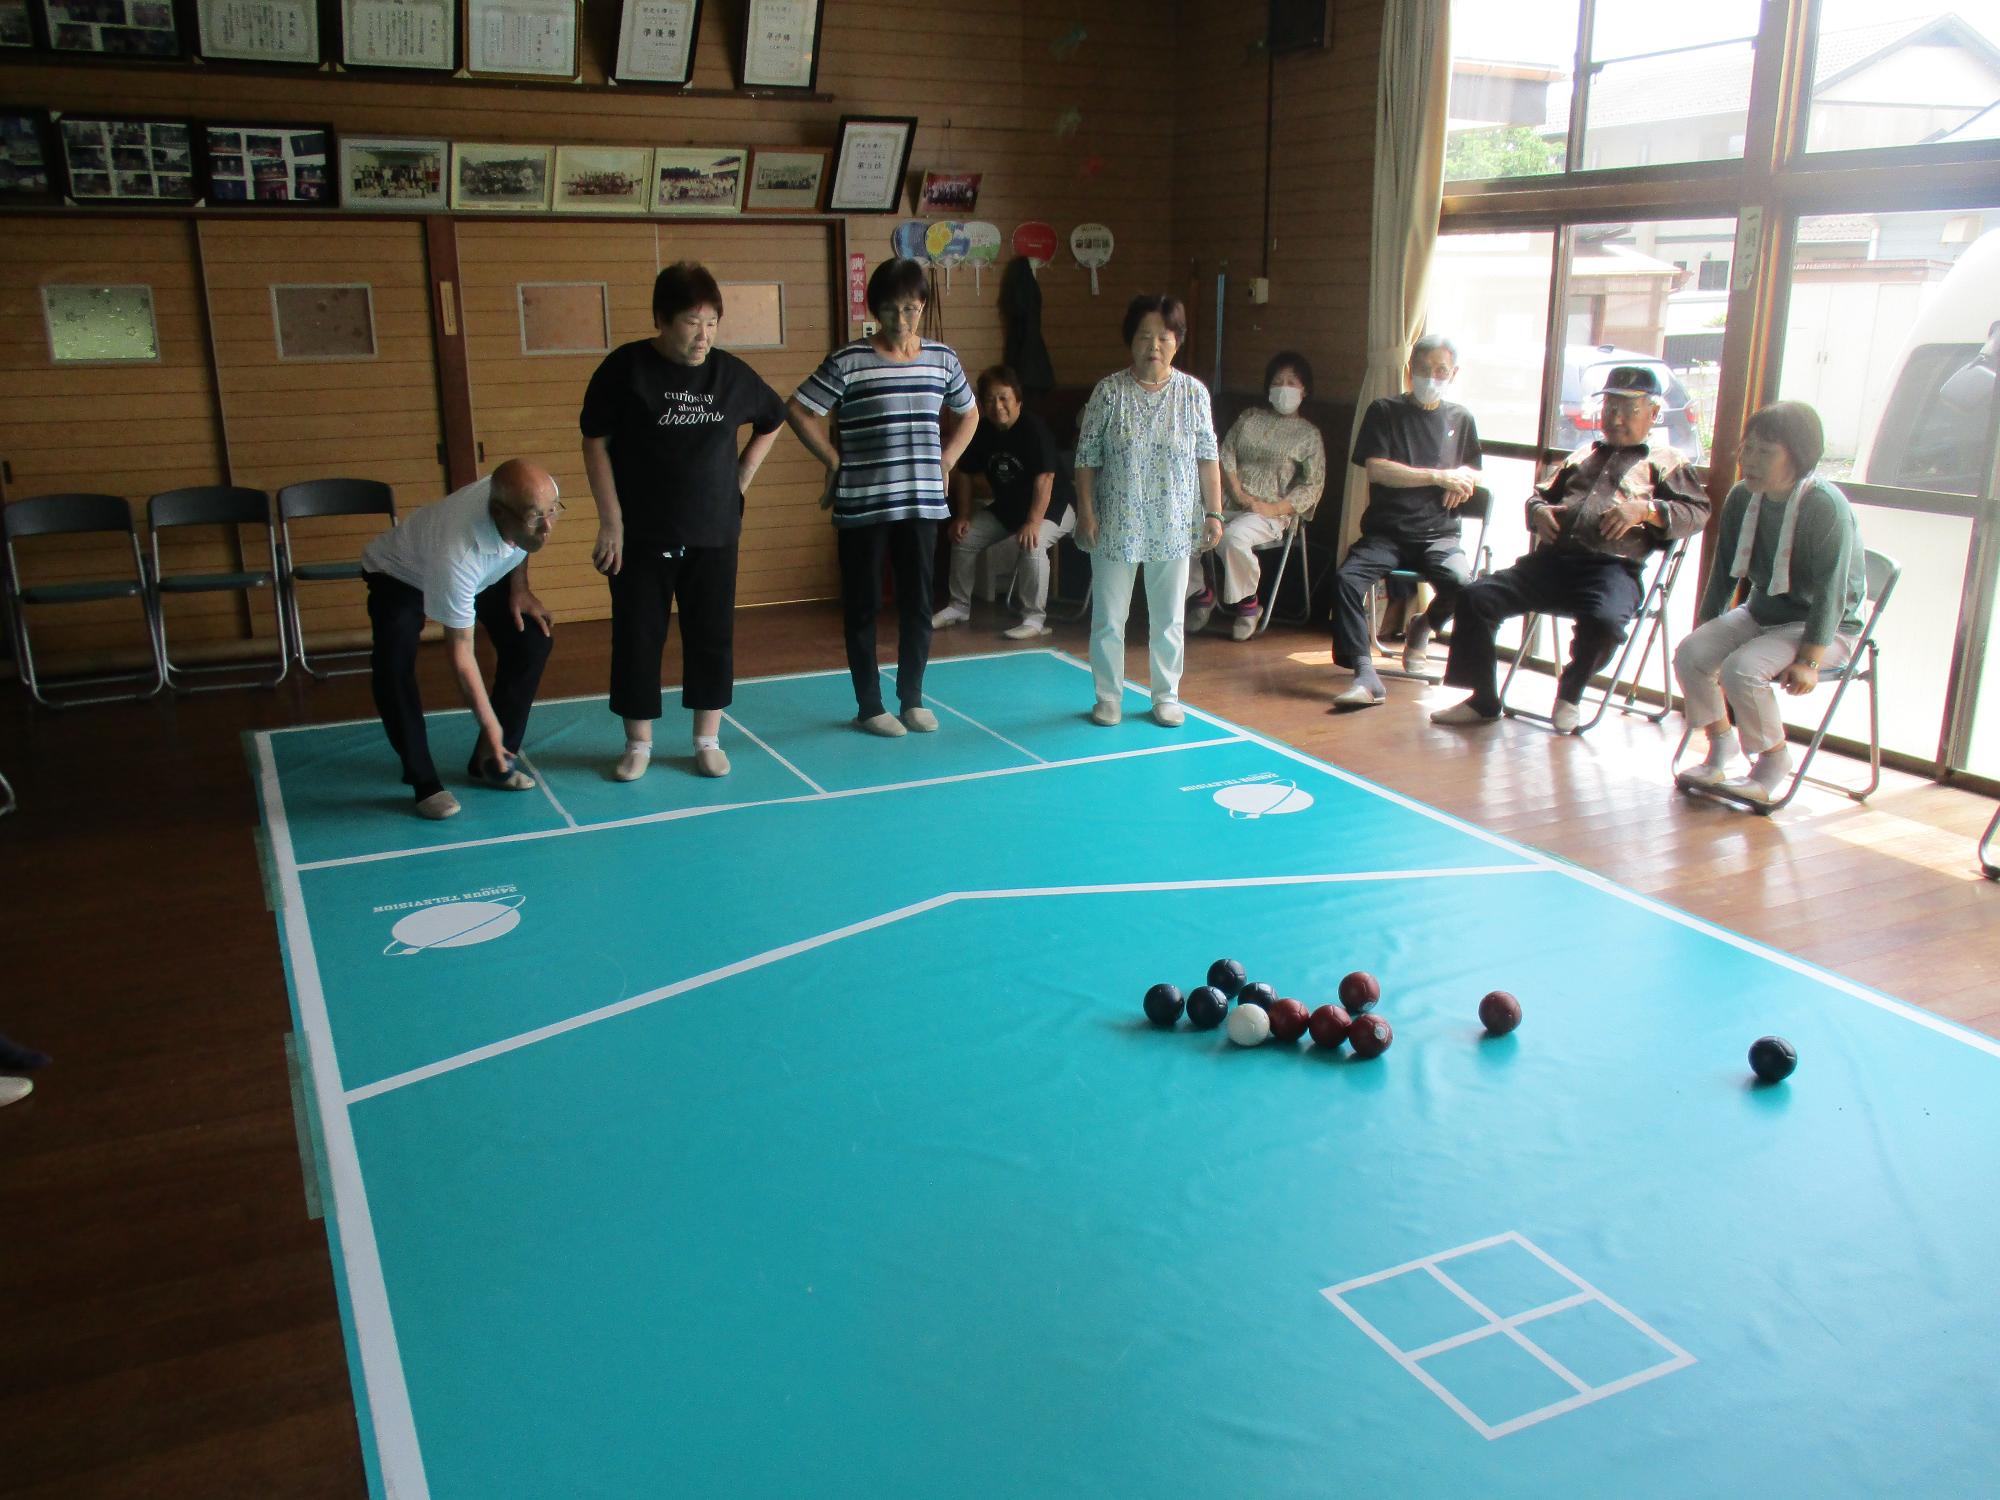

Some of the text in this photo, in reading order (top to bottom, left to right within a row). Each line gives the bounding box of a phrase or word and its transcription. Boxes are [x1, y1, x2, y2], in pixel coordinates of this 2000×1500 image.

[851, 256, 864, 303] 消火器
[664, 390, 714, 405] curiosity
[657, 407, 725, 426] dreams
[678, 403, 705, 413] about
[372, 894, 461, 913] TELEVISION
